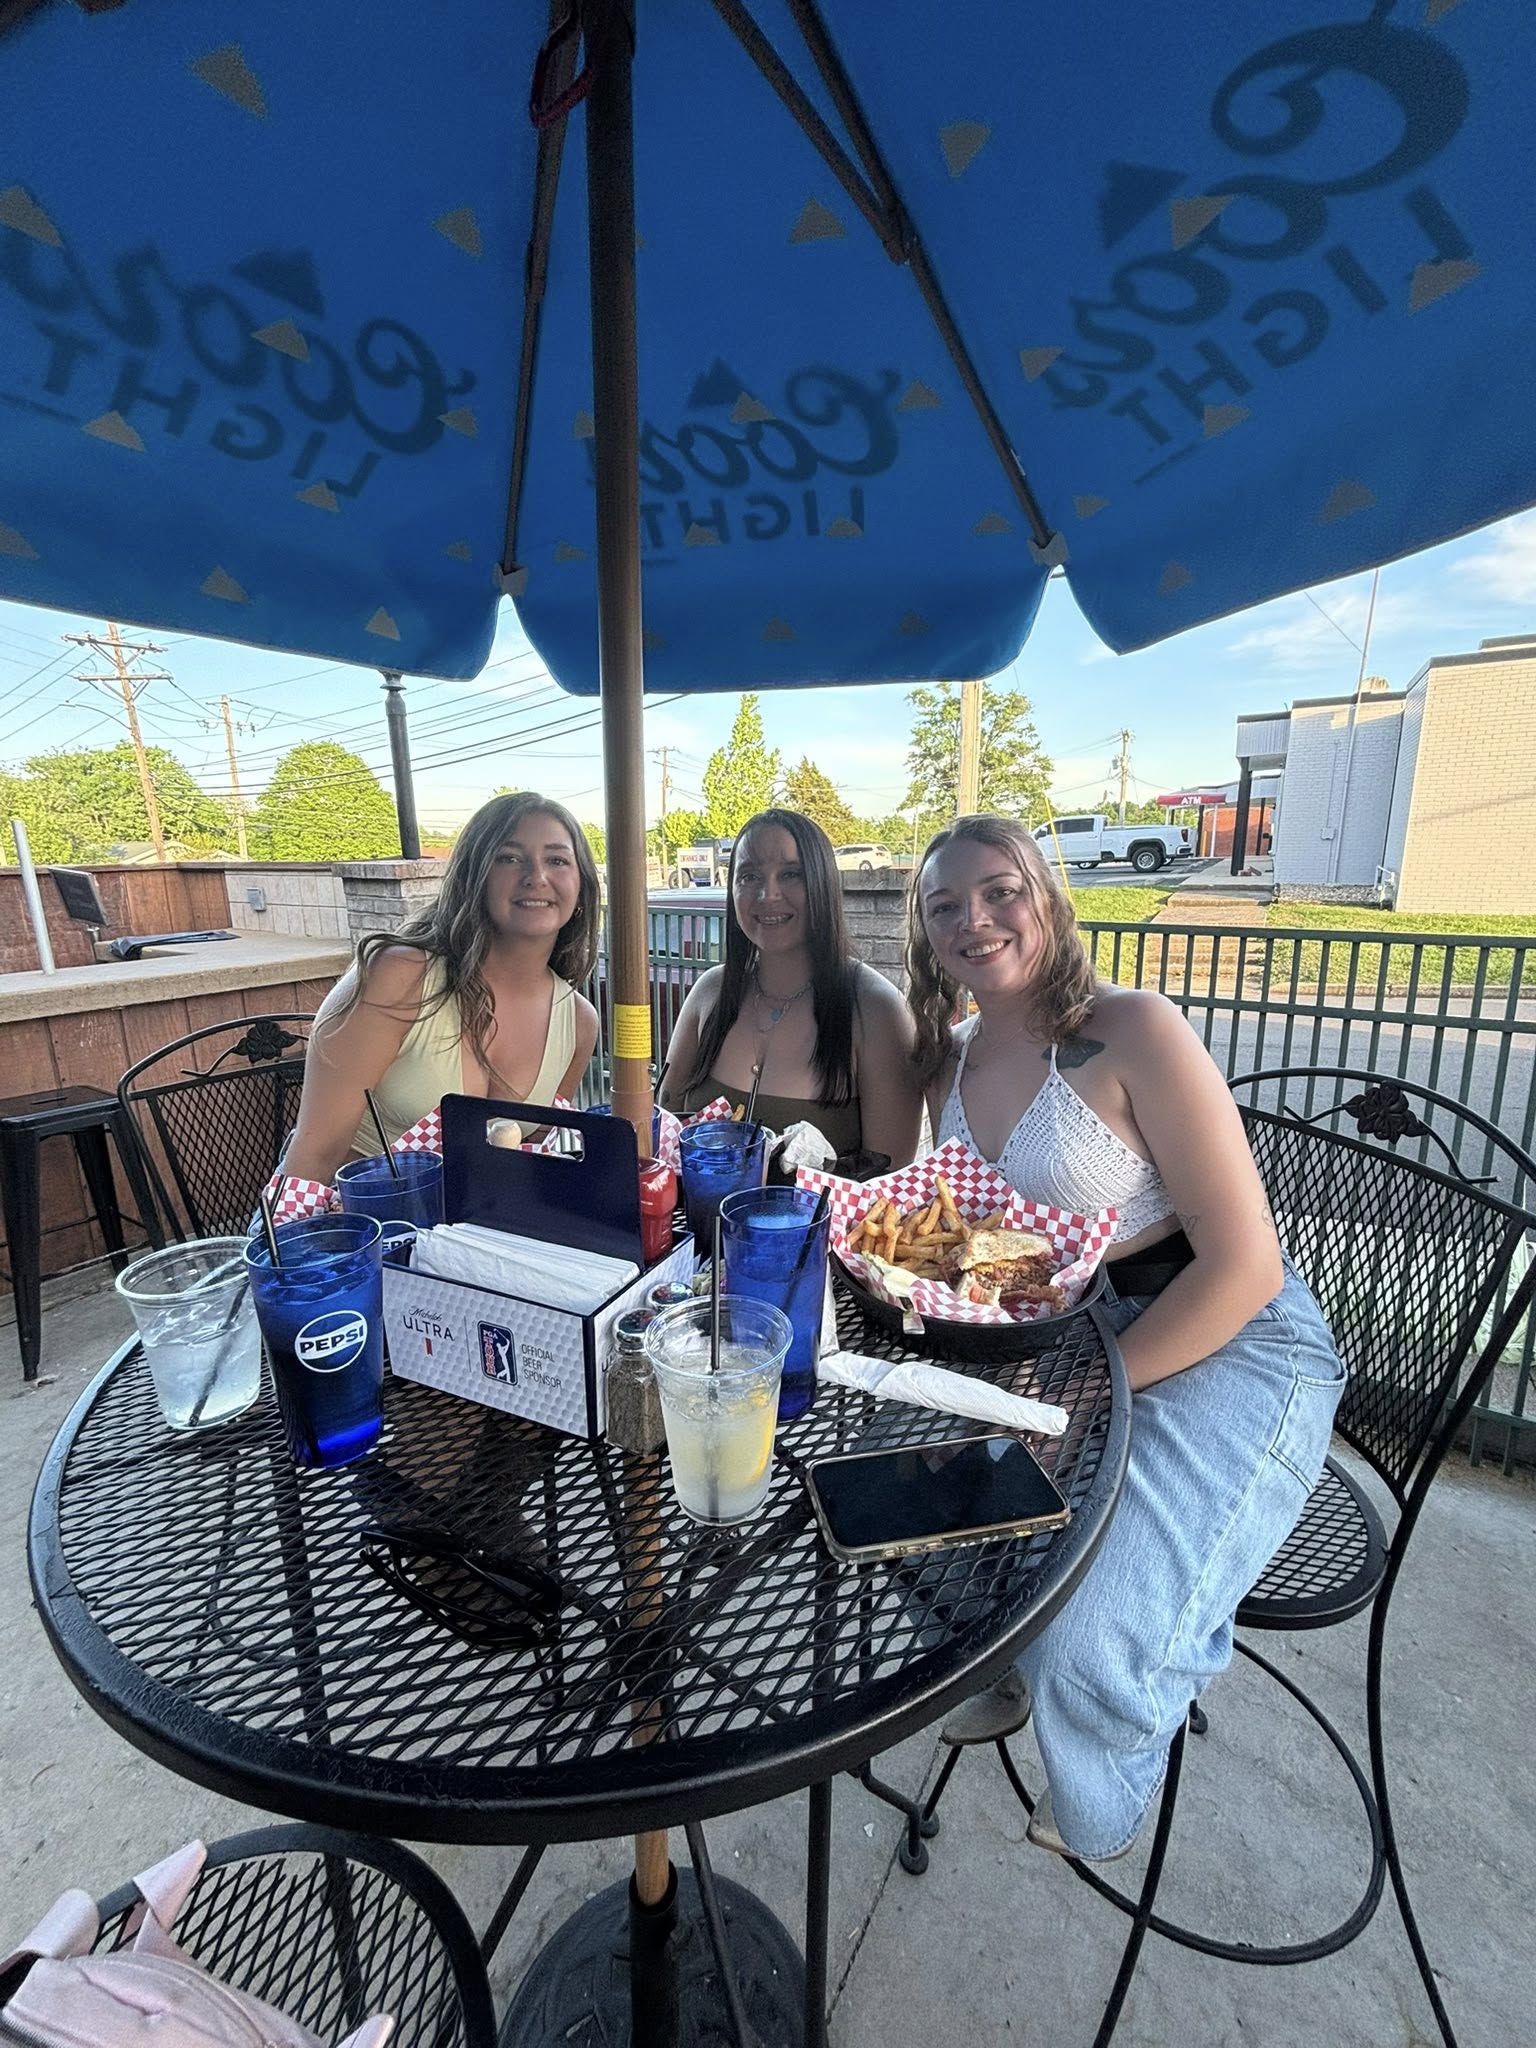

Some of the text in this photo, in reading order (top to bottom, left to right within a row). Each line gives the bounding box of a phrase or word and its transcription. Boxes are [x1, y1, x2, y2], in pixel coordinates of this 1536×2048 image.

[1181, 796, 1202, 805] ATM
[403, 1315, 455, 1341] ULTRA
[483, 1329, 499, 1339] PGA
[300, 1324, 364, 1354] PEPSI
[521, 1343, 555, 1362] OFFICIAL
[522, 1356, 542, 1371] BEER
[523, 1368, 562, 1389] SPONSOR
